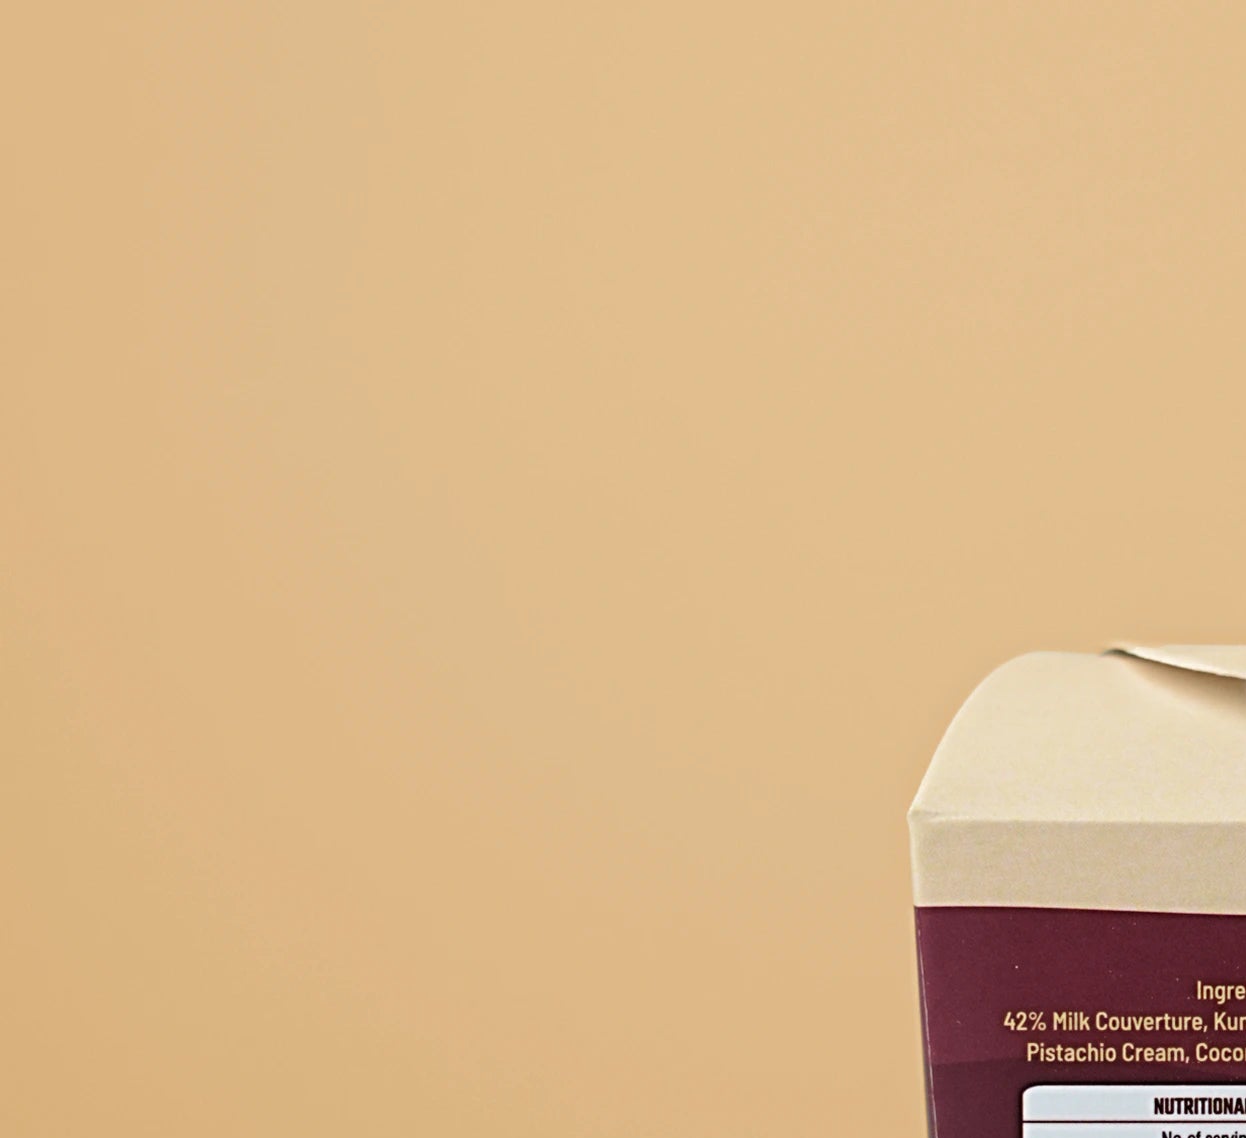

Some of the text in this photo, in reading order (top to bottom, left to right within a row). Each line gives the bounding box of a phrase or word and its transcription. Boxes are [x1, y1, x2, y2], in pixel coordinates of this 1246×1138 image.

[1003, 1011, 1047, 1031] 42%
[1053, 1011, 1091, 1031] Milk
[1095, 1011, 1208, 1033] Couverture,
[1027, 1042, 1117, 1062] Pistachio
[1122, 1042, 1190, 1064] Cream,
